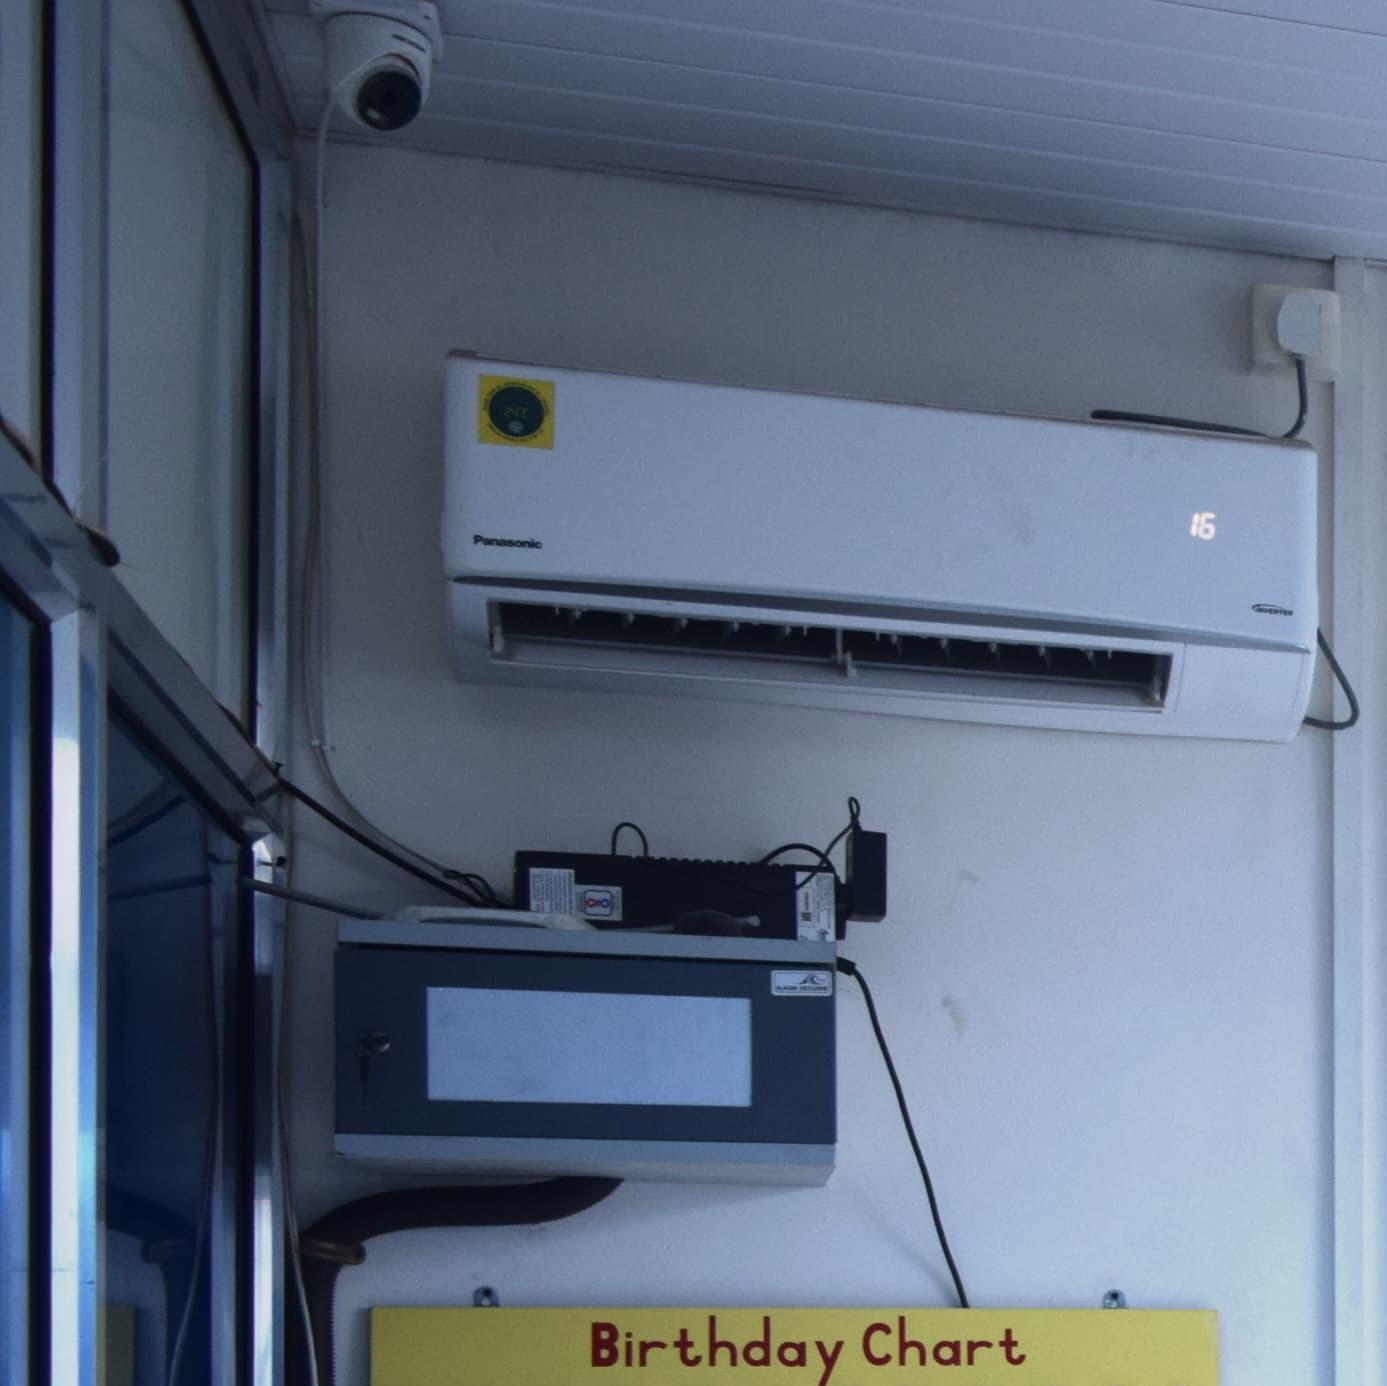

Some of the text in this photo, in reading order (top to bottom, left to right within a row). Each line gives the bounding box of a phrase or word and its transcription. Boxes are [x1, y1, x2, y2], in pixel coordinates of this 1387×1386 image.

[1190, 512, 1216, 540] 16
[473, 534, 543, 549] Panasonic
[862, 1315, 1026, 1367] Chart
